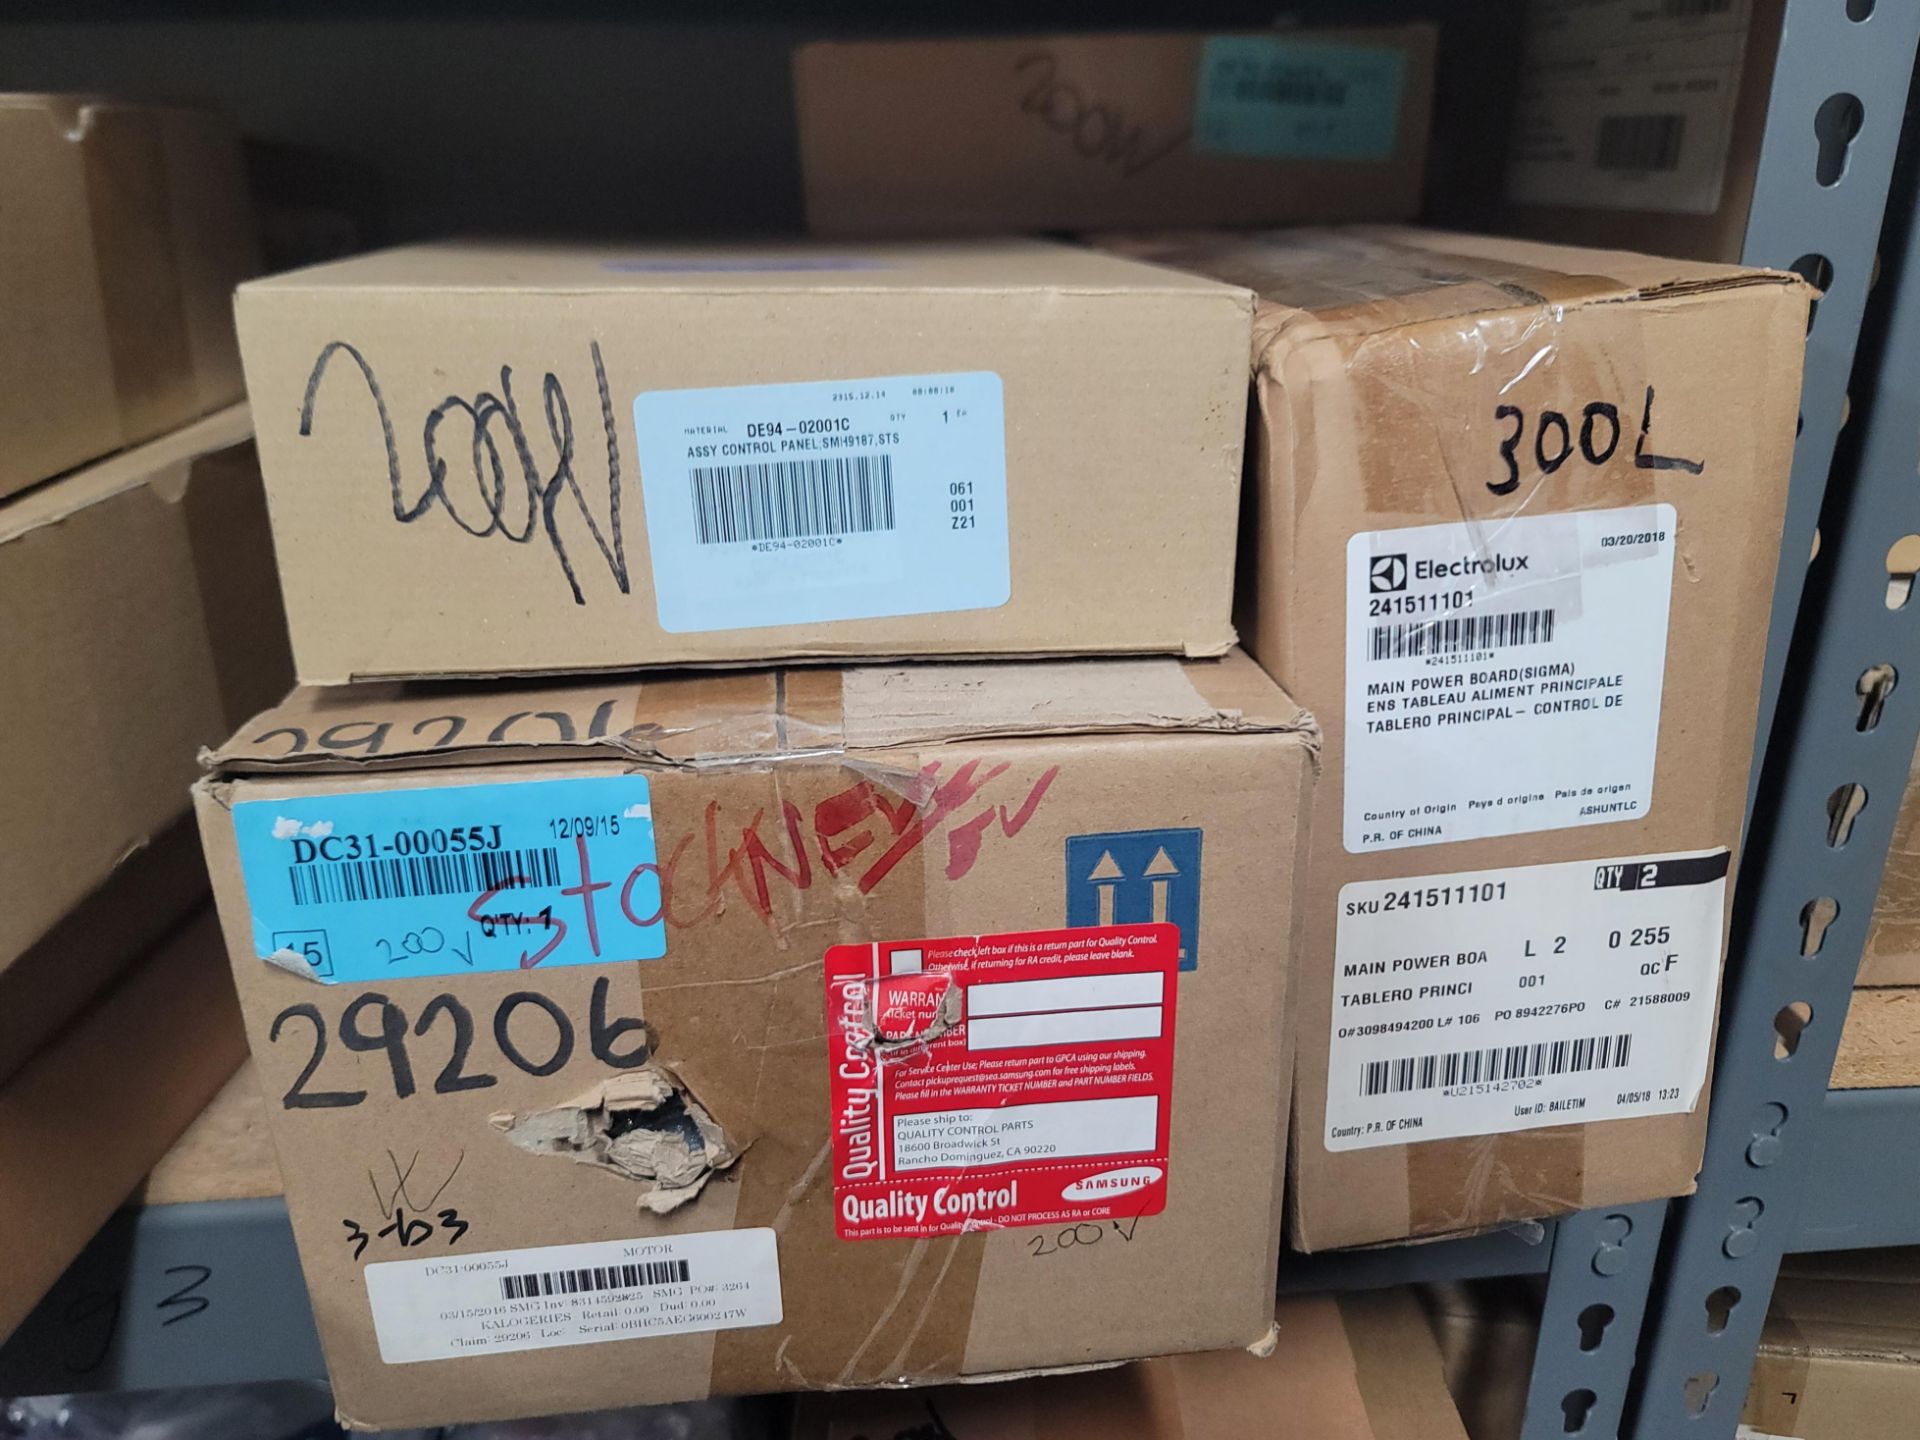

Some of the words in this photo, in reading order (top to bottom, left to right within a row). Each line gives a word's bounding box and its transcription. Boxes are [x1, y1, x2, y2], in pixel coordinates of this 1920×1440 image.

[747, 417, 850, 438] DE94-02001C
[1485, 385, 1704, 496] 300L
[687, 444, 717, 458] ASSY
[722, 440, 776, 456] CONTROL
[950, 482, 973, 496] 061
[950, 499, 974, 512] 001
[952, 516, 976, 530] Z21
[1601, 531, 1665, 547] 03/20/2018
[1415, 553, 1528, 580] Electrolux
[1369, 590, 1473, 617] 241511101
[1367, 680, 1404, 696] MAIN
[1411, 674, 1463, 691] POWER
[1470, 662, 1575, 685] BOARD(SIGMA)
[1367, 700, 1396, 713] ENS
[1402, 691, 1466, 709] TABLEAU
[1471, 684, 1535, 702] ALIMENT
[1540, 674, 1623, 694] PRINCIPALE
[1366, 715, 1431, 734] TABLERO
[1534, 698, 1599, 715] CONTROL
[1604, 694, 1623, 708] DE
[1364, 810, 1406, 821] Country
[1424, 804, 1456, 814] Origin
[1468, 799, 1493, 809] Pays
[1507, 793, 1544, 804] origine
[1555, 789, 1576, 799] Pais
[1597, 783, 1631, 794] origen
[1579, 800, 1638, 816] ASHUNTLC
[549, 815, 620, 840] 12/09/15
[1362, 832, 1384, 843] P.R.
[1389, 830, 1404, 840] OF
[1408, 825, 1442, 838] CHINA
[291, 824, 503, 864] DC31-00055J
[1346, 900, 1379, 916] SKU
[1384, 881, 1506, 911] 241511101
[1595, 866, 1622, 889] QTY
[1640, 864, 1658, 887] 2
[928, 948, 954, 958] Please
[1043, 941, 1068, 950] return
[1067, 940, 1086, 950] part
[1086, 938, 1098, 948] for
[1098, 935, 1126, 947] Quality
[1127, 934, 1158, 945] Control.
[977, 957, 1014, 968] returning
[1014, 956, 1026, 966] for
[1027, 956, 1038, 964] RA
[1064, 952, 1089, 964] please
[1089, 950, 1110, 960] leave
[1110, 948, 1134, 959] blank.
[1344, 961, 1385, 977] MAIN
[1392, 954, 1450, 972] POWER
[1456, 950, 1487, 965] BOA
[1524, 940, 1536, 957] L
[1553, 936, 1566, 954] 2
[1630, 925, 1670, 947] 255
[1341, 988, 1412, 1007] TABLERO
[1419, 981, 1472, 998] PRINCI
[1518, 974, 1545, 988] 001
[1664, 954, 1679, 972] F
[1437, 1017, 1452, 1028] L#
[1458, 1013, 1480, 1025] 106
[1494, 1009, 1512, 1020] PO
[1604, 999, 1621, 1010] C#
[1629, 991, 1690, 1007] 21588009
[270, 976, 658, 1110] 29206
[979, 1058, 1004, 1068] Please
[1055, 1053, 1076, 1063] GPCA
[1077, 1052, 1098, 1062] using
[1113, 1049, 1147, 1060] shipping.
[894, 1078, 925, 1089] Contact
[1079, 1063, 1112, 1074] shipping
[1112, 1061, 1136, 1071] labels.
[894, 1090, 919, 1101] Please
[939, 1086, 953, 1096] the
[953, 1084, 996, 1095] WARRANTY
[998, 1082, 1022, 1092] TICKET
[1024, 1080, 1056, 1091] NUMBER
[1057, 1077, 1073, 1087] and
[1074, 1076, 1094, 1086] PART
[1094, 1074, 1127, 1084] NUMBER
[1127, 1072, 1153, 1082] FIELDS.
[1514, 1104, 1532, 1116] User
[1534, 1102, 1546, 1115] ID:
[1549, 1098, 1586, 1112] BAILETIM
[1617, 1091, 1650, 1105] 04/05/18
[1658, 1088, 1680, 1101] 13:23
[840, 1088, 878, 1179] Quality
[897, 1118, 931, 1128] Please
[934, 1115, 956, 1126] ship
[958, 1114, 973, 1122] to:
[897, 1128, 945, 1141] QUALITY
[947, 1124, 998, 1136] CONTROL
[1002, 1120, 1034, 1130] PARTS
[1332, 1120, 1364, 1139] Country:
[1366, 1118, 1383, 1134] P.R.
[1386, 1118, 1398, 1130] OF
[1399, 1116, 1423, 1129] CHINA
[898, 1142, 930, 1153] 18600
[933, 1138, 988, 1151] Broadwick
[990, 1137, 1000, 1146] St
[898, 1154, 938, 1166] Rancho
[940, 1150, 1004, 1163] Dominguez,
[1006, 1147, 1022, 1156] CA
[1023, 1144, 1056, 1154] 90220
[1075, 1175, 1152, 1192] SAMSUNG
[842, 1189, 928, 1224] Quality
[933, 1180, 1017, 1216] Control
[844, 1228, 859, 1238] This
[860, 1227, 876, 1238] part
[903, 1224, 919, 1232] sent
[998, 1215, 1009, 1223] DO
[1011, 1213, 1026, 1222] NOT
[1027, 1211, 1060, 1221] PROCESS
[1071, 1209, 1082, 1217] RA
[1091, 1206, 1111, 1216] CORE
[623, 1243, 674, 1258] MOTOR
[156, 1265, 212, 1328] 3
[509, 1301, 540, 1314] SMG
[653, 1287, 683, 1299] SMG
[481, 1312, 572, 1330] KALOGERIES
[624, 1305, 649, 1316] 0.00
[578, 1321, 617, 1334] Serial:
